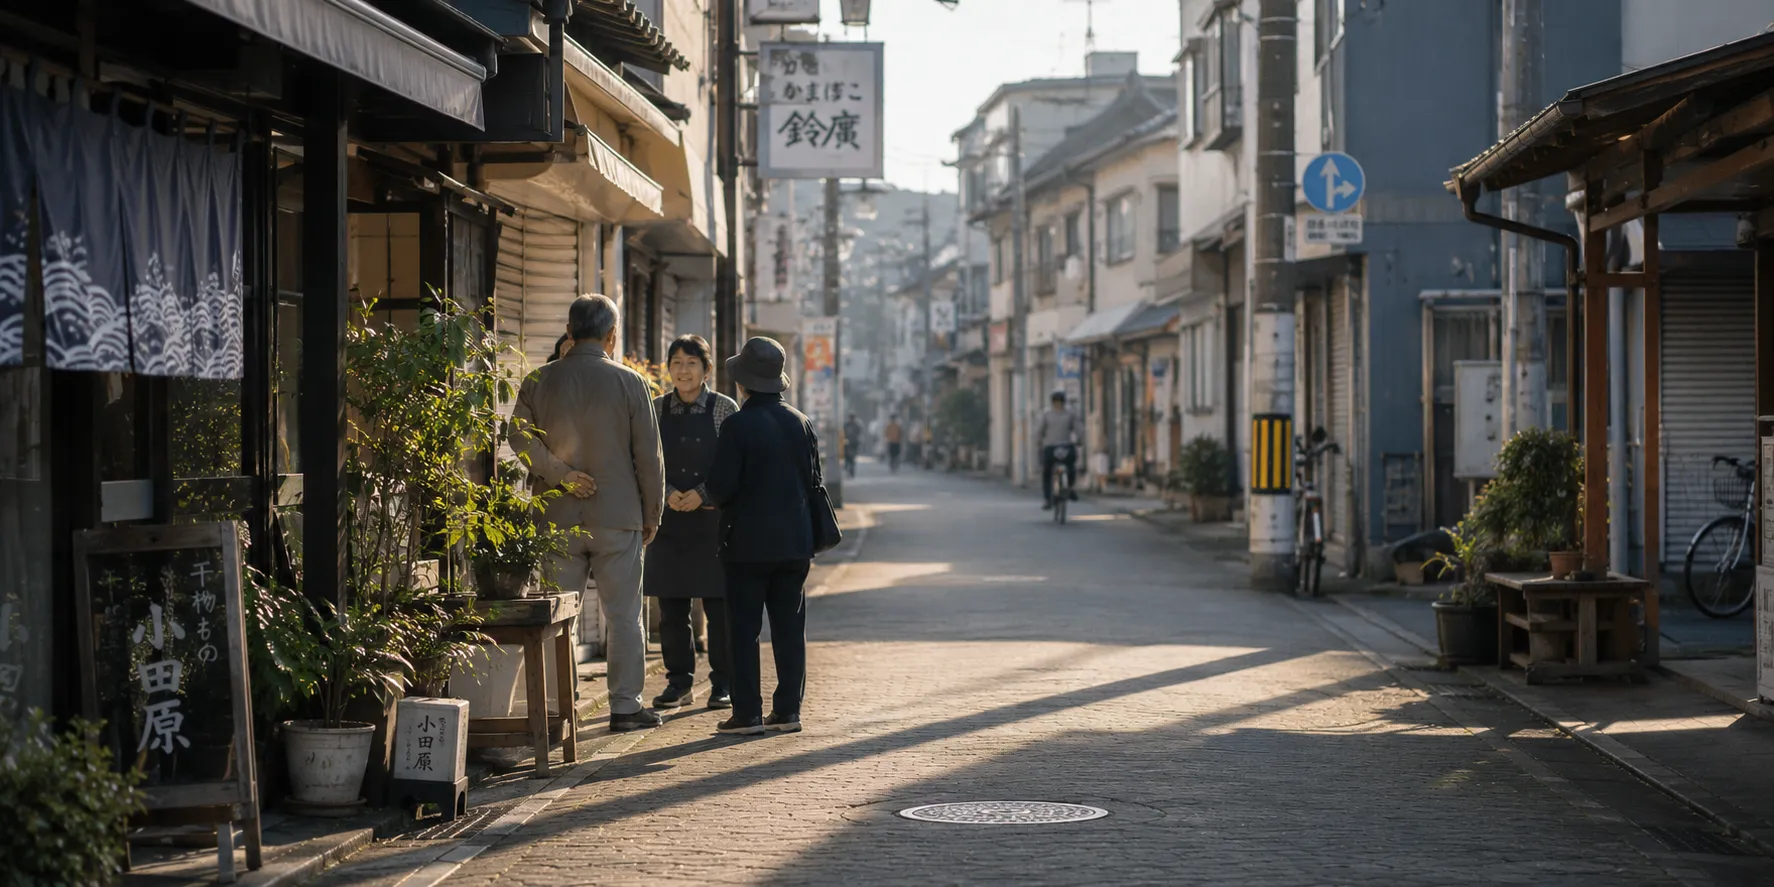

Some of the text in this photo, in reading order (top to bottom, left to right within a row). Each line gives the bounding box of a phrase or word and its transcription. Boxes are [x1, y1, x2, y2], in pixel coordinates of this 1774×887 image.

[777, 110, 861, 151] 鈴廣
[131, 603, 191, 755] 小田原
[412, 714, 437, 772] 小田原
